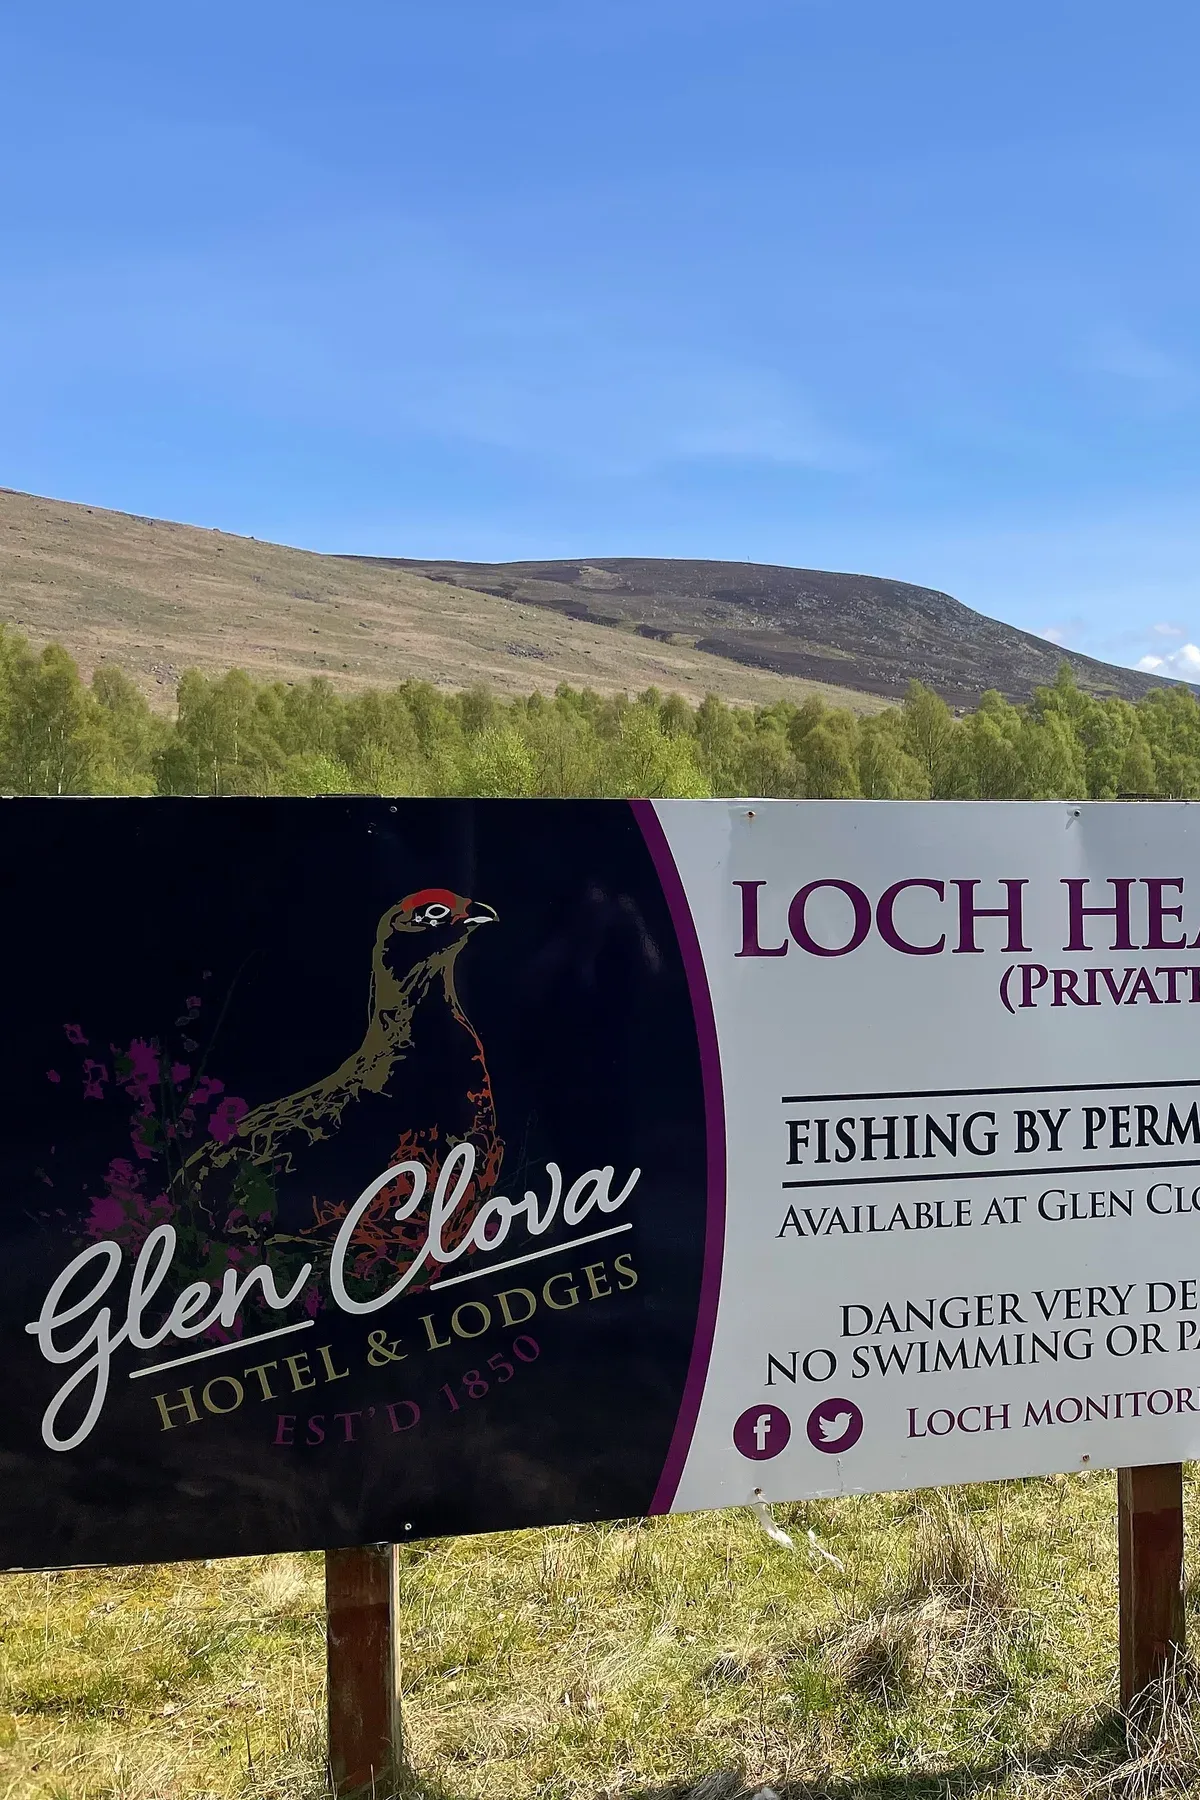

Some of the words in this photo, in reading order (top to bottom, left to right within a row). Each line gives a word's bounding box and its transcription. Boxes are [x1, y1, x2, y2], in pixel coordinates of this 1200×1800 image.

[733, 878, 1031, 958] LOCH
[785, 1111, 999, 1165] FISHING
[1014, 1108, 1071, 1152] BY
[776, 1198, 972, 1239] AVAILABLE
[981, 1196, 1027, 1224] AT
[1037, 1188, 1134, 1221] GLEN
[25, 1224, 313, 1452] Glen
[330, 1142, 642, 1315] Clova
[840, 1293, 1026, 1338] DANGER
[1033, 1283, 1136, 1322] VERY
[150, 1345, 349, 1432] HOTEL
[366, 1328, 409, 1368] &
[418, 1253, 640, 1352] LODGES
[440, 1334, 542, 1412] 1850
[766, 1348, 838, 1386] NO
[851, 1326, 1094, 1380] SWIMMING
[1106, 1323, 1166, 1356] OR
[907, 1405, 1011, 1439] LOCH
